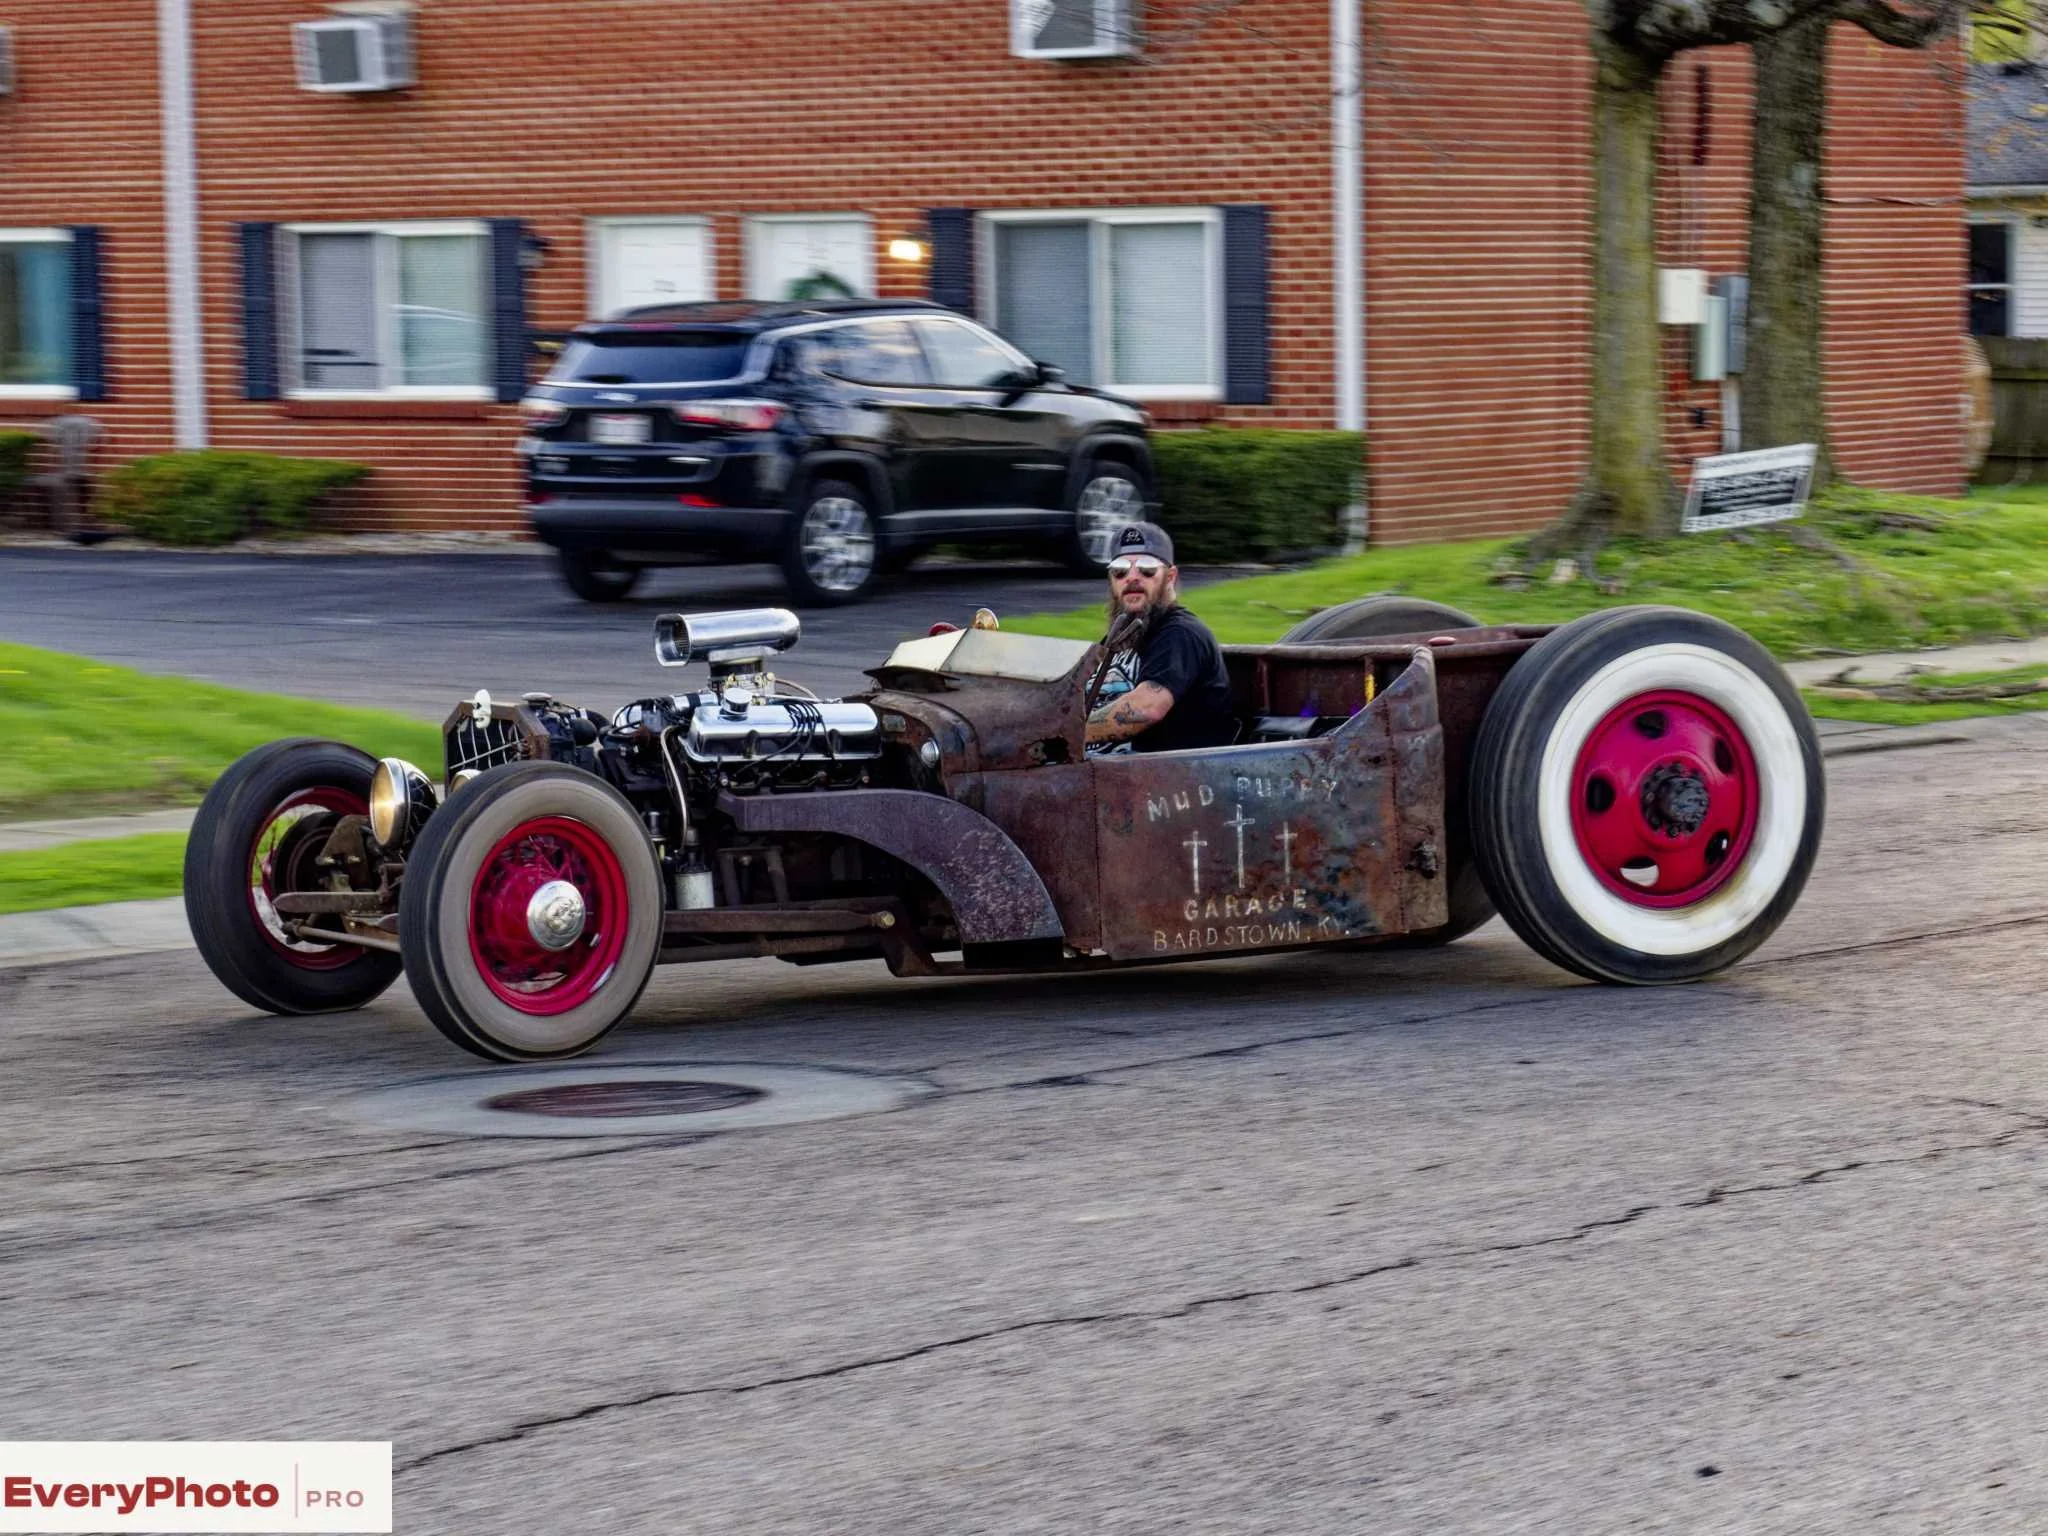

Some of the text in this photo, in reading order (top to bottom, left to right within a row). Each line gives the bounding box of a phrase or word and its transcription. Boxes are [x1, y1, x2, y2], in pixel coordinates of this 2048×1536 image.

[1147, 776, 1337, 822] MUD PUPPY
[1184, 889, 1307, 921] GARAGE
